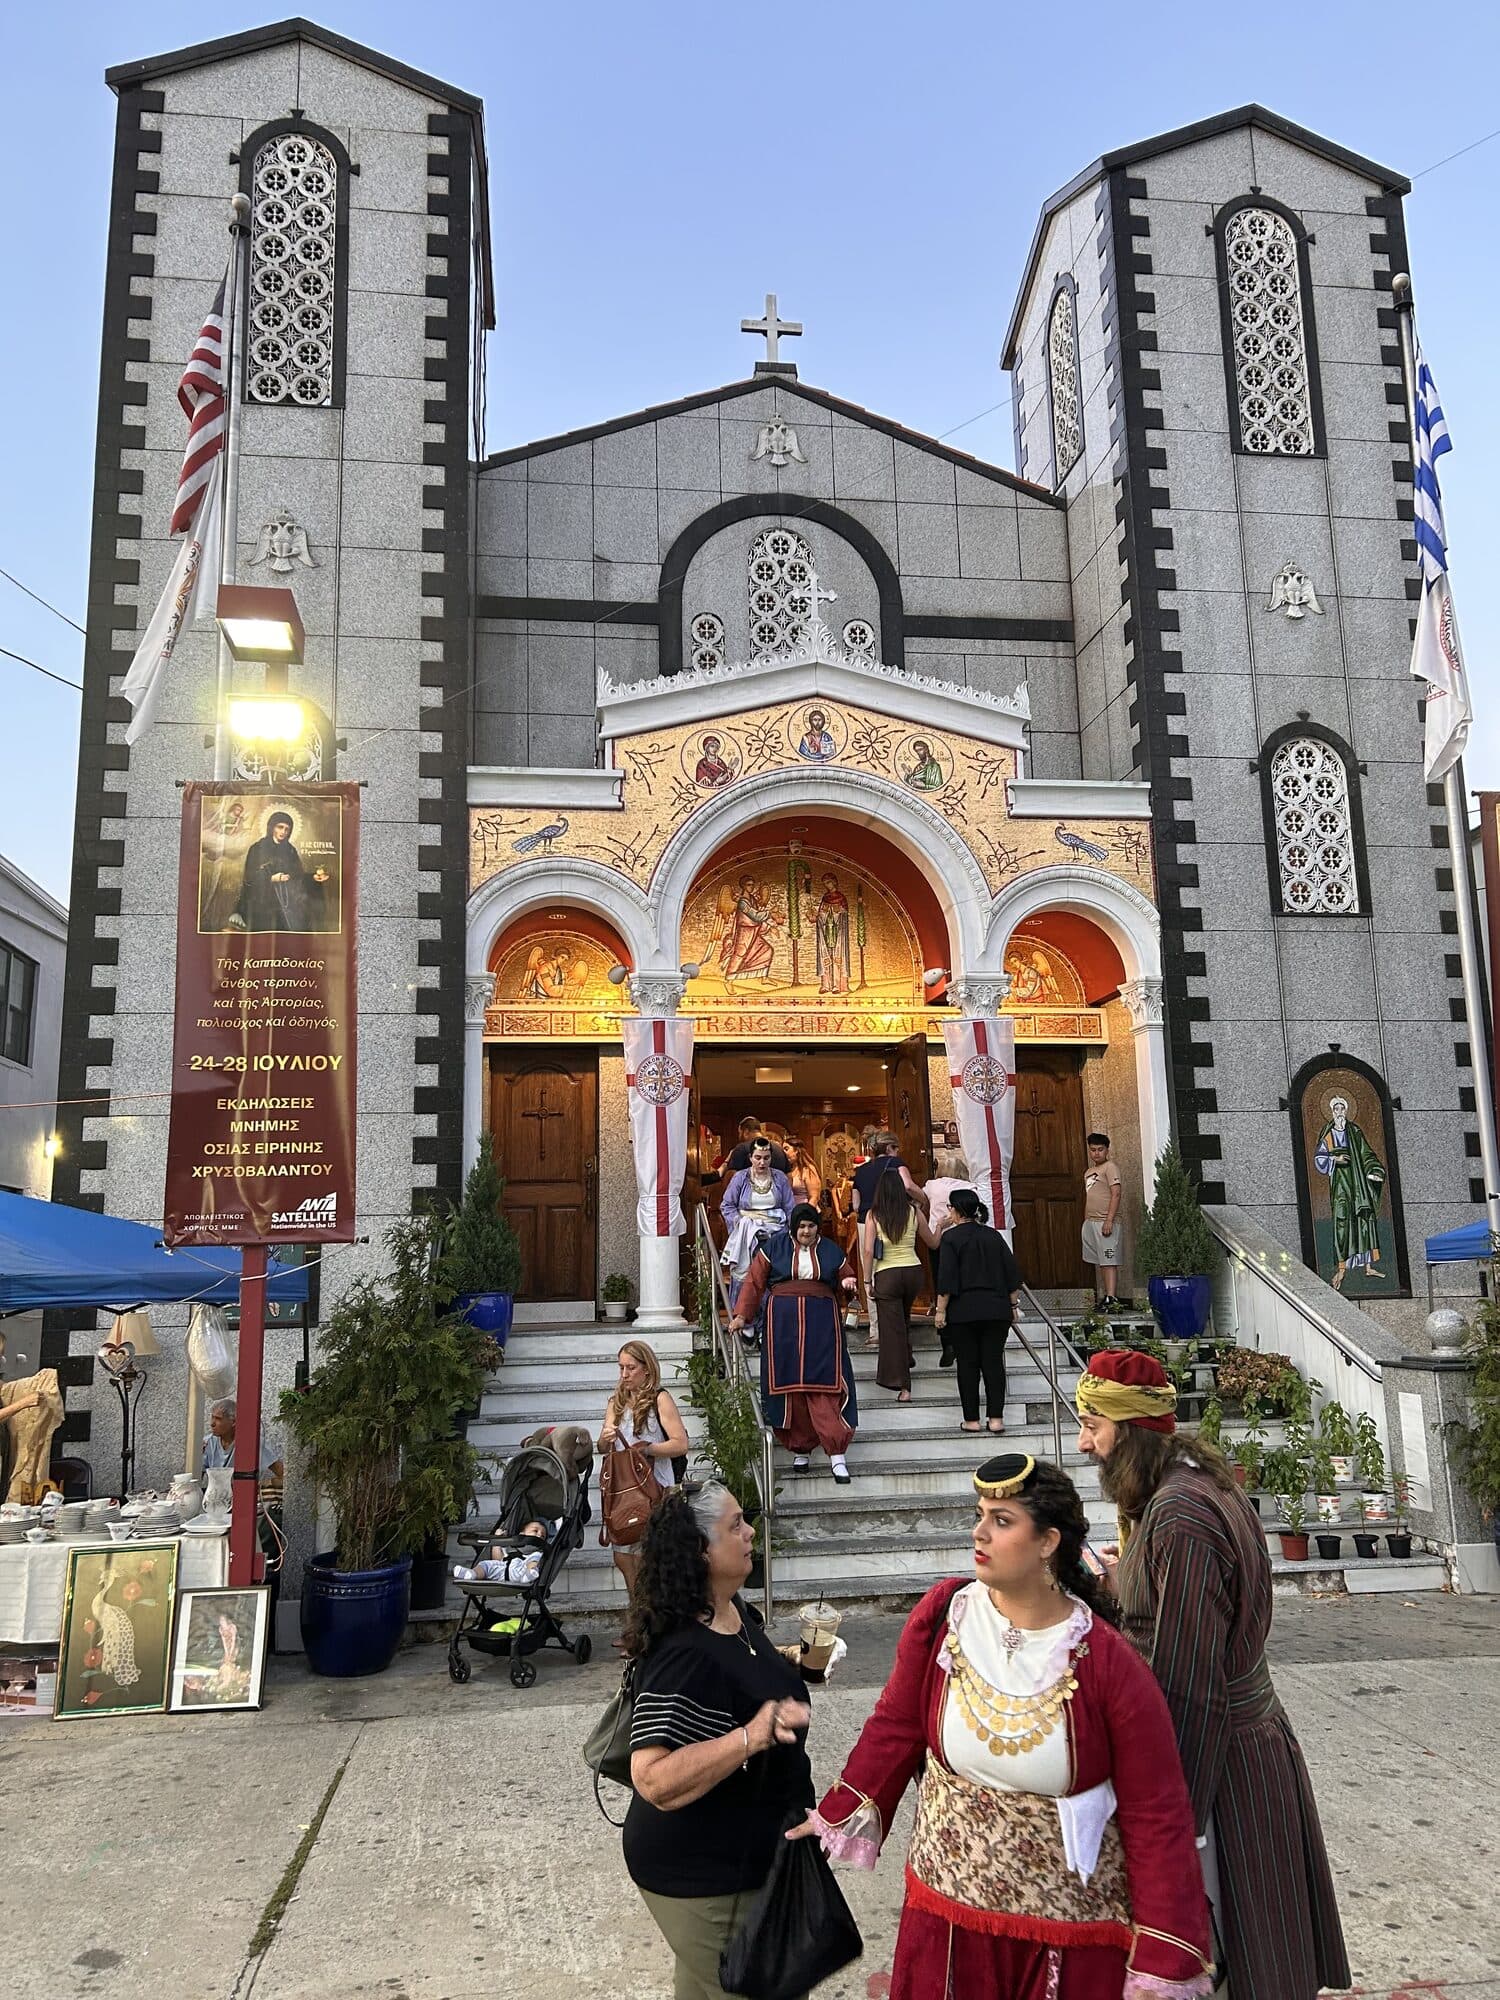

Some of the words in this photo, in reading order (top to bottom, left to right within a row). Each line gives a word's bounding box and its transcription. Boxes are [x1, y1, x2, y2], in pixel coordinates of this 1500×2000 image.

[243, 957, 325, 970] Καππαδοκίας
[190, 1055, 247, 1072] 24-28
[253, 1055, 342, 1071] ΙΟΥΛΙΟΥ
[216, 1097, 315, 1110] ΕΚΔΗΛΩΣΕΙΣ
[230, 1119, 300, 1133] ΜΝΗΜΗΣ
[203, 1143, 251, 1155] ΟΣΙΑΣ
[254, 1141, 324, 1154] ΕΙΡΗΝΗΣ
[191, 1164, 333, 1178] ΧΡΥΣΟΒΑΛΑΝΤΟΥ
[184, 1213, 245, 1221] ΑΠΟΚΛΕΙΣΤΙΚΟΣ
[271, 1211, 337, 1222] SATELLITE
